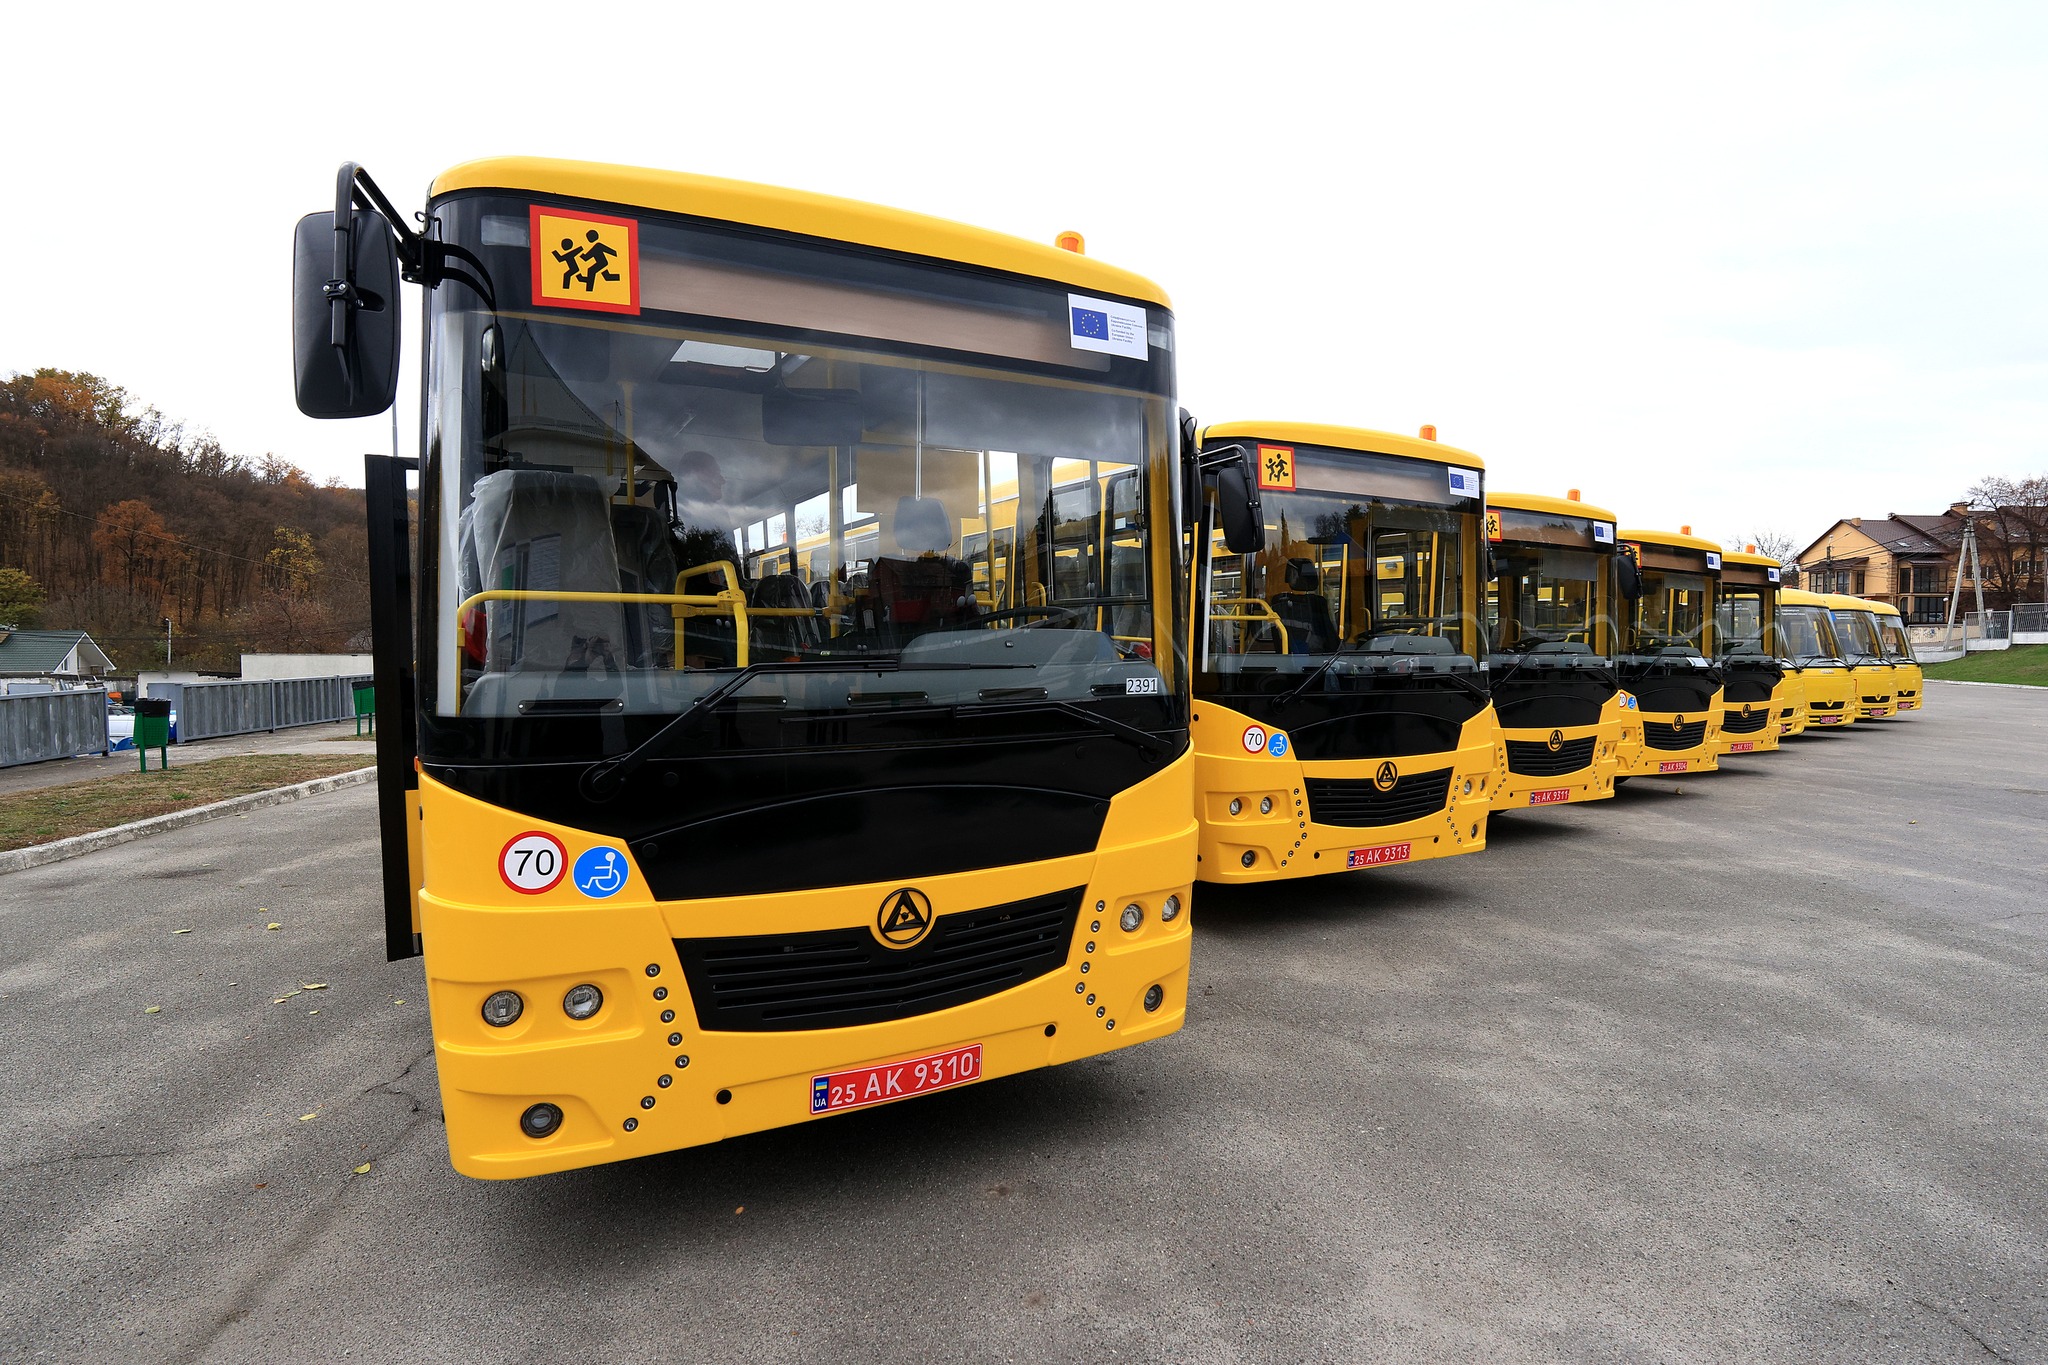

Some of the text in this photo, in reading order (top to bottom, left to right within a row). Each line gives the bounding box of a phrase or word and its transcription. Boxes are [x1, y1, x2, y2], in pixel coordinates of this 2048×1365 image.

[1127, 679, 1157, 693] 2391
[1247, 733, 1263, 746] 70
[1541, 792, 1552, 802] AK
[1552, 790, 1568, 801] 9311
[1355, 846, 1408, 865] 25 AK 9313
[514, 849, 555, 877] 70
[831, 1052, 974, 1106] 25 AK 9310
[814, 1098, 827, 1108] UA
